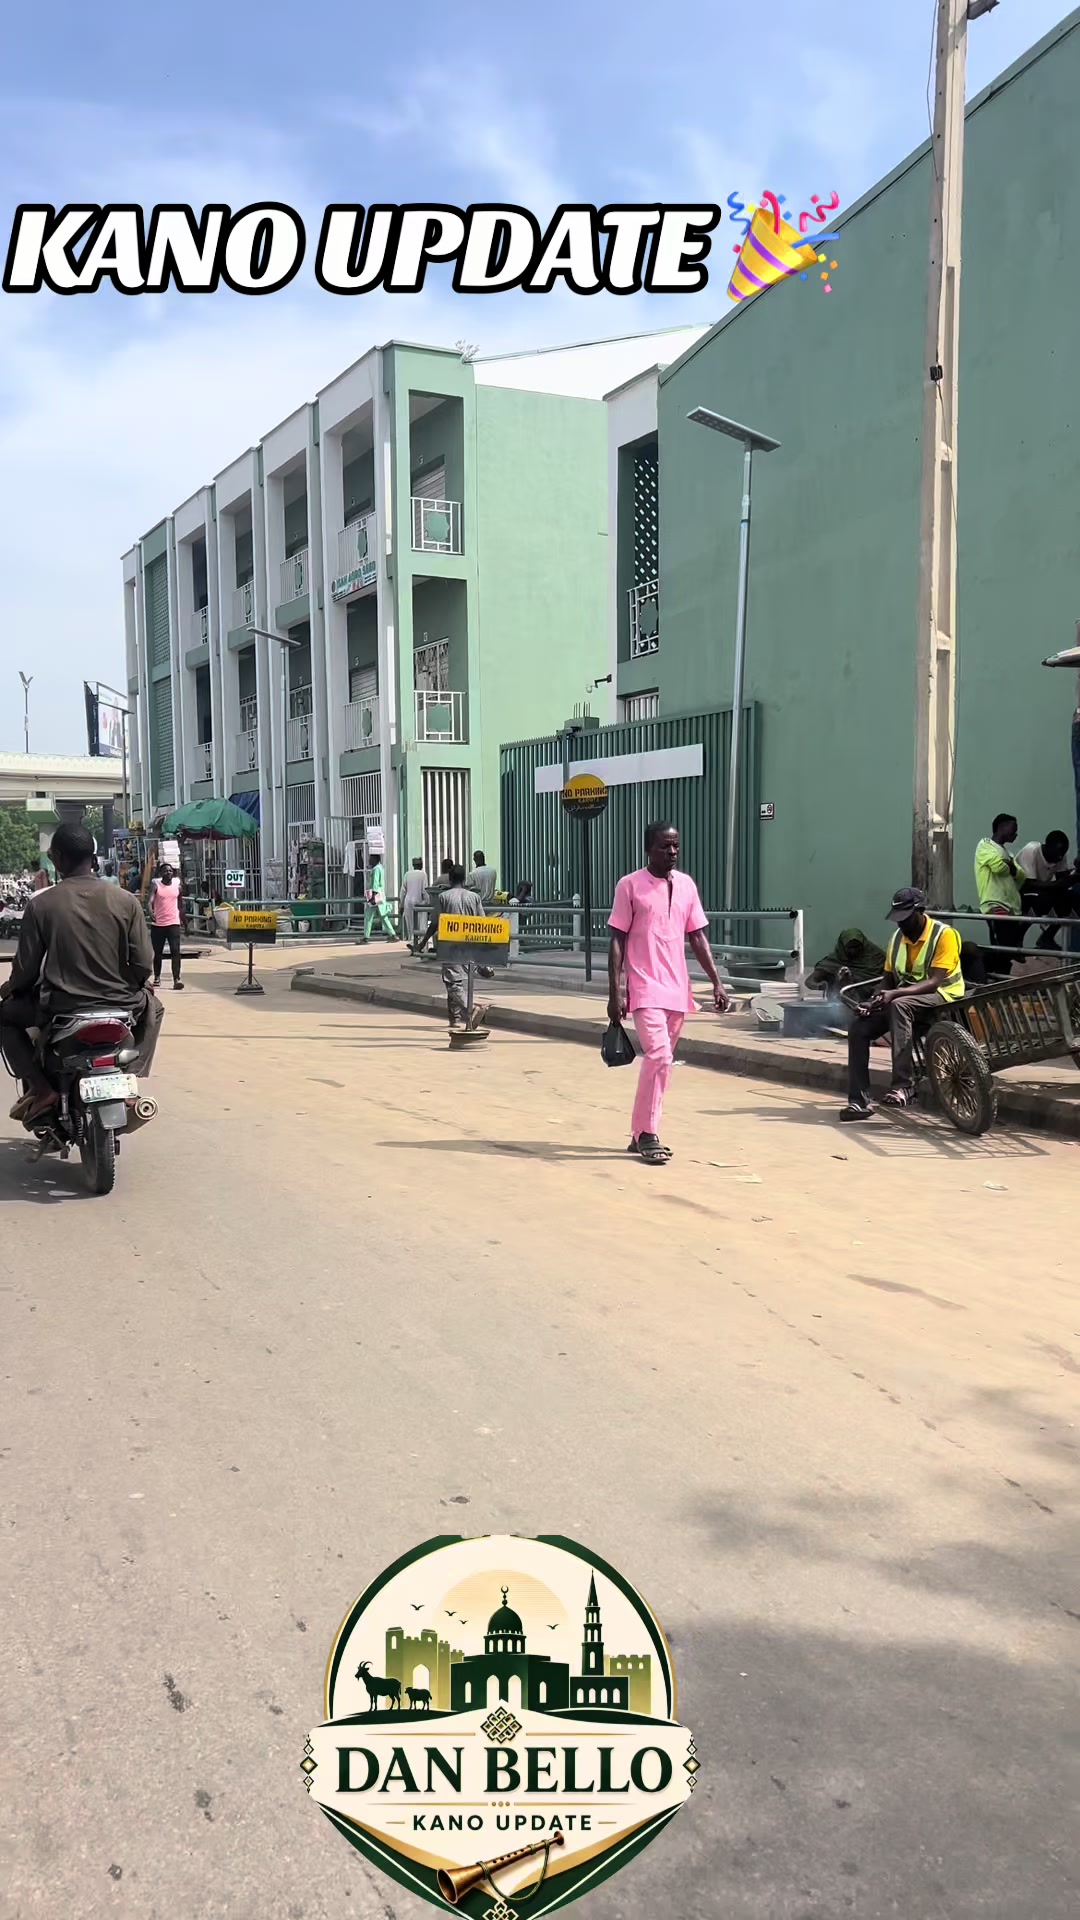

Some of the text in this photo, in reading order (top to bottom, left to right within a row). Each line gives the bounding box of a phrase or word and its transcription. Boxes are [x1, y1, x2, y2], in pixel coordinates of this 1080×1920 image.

[563, 788, 573, 798] NO
[226, 873, 244, 882] OUT
[233, 915, 272, 923] NO PARKING
[446, 921, 503, 934] NO PARKING
